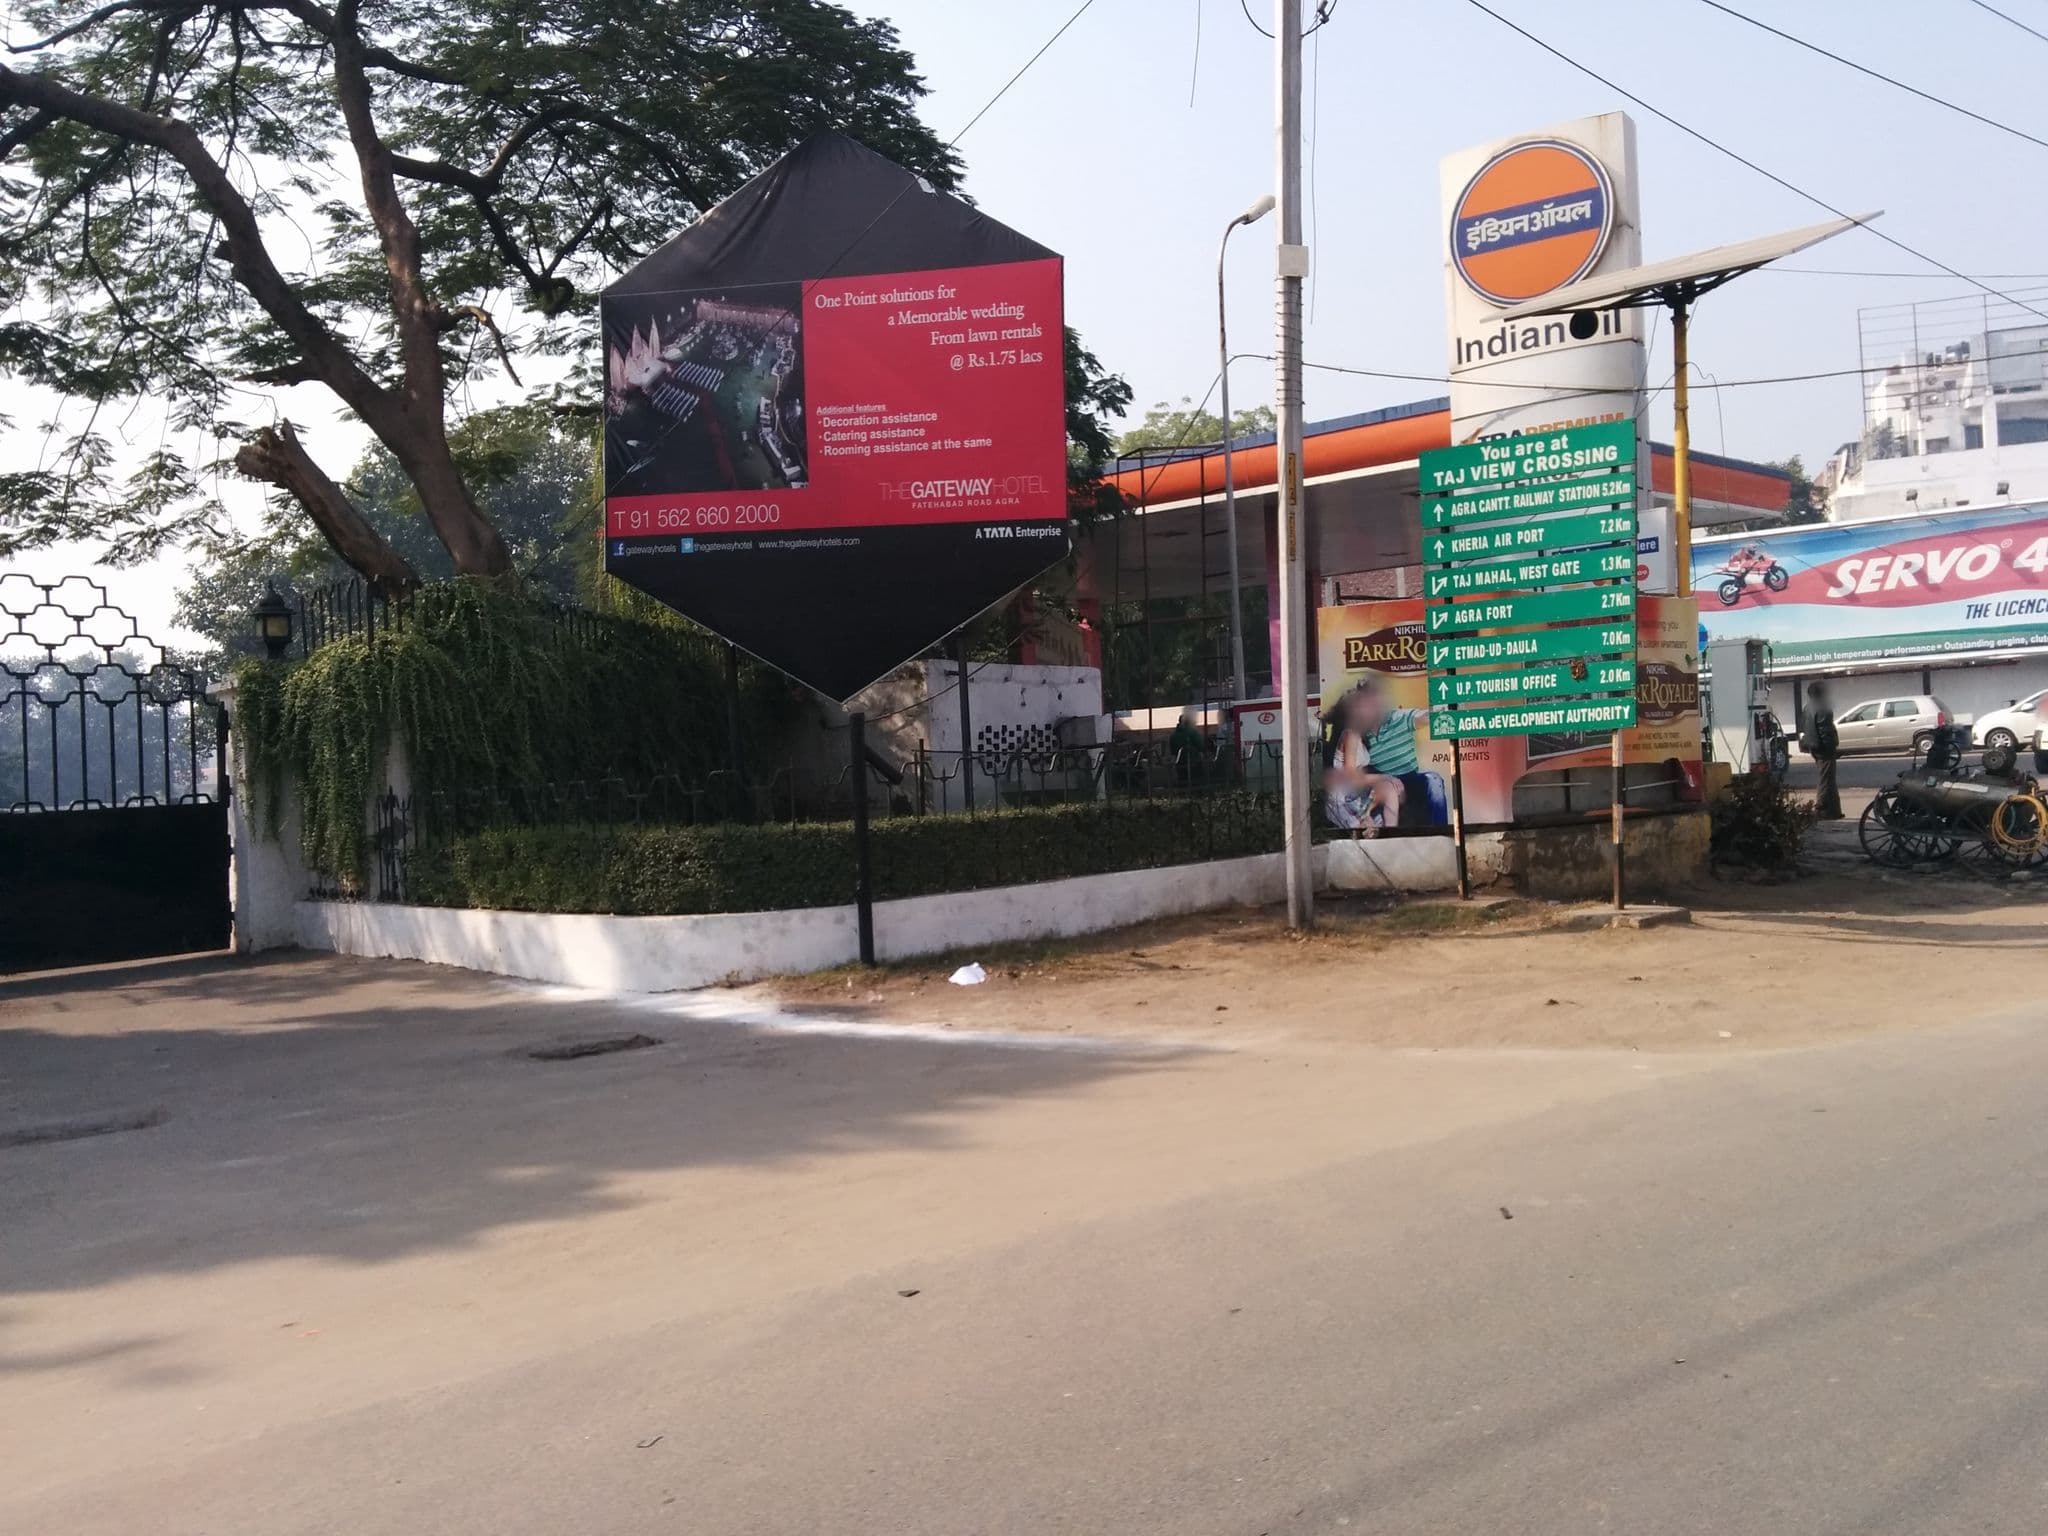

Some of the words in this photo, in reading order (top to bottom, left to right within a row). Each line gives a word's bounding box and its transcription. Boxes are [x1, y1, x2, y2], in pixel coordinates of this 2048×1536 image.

[815, 294, 841, 309] One
[844, 289, 877, 306] Point
[880, 285, 934, 304] solutions
[937, 285, 956, 299] for
[888, 315, 895, 326] a
[899, 305, 968, 325] Memorable
[972, 302, 1025, 320] wedding
[931, 328, 964, 346] From
[968, 327, 998, 343] lawn
[1001, 323, 1042, 340] rentals
[951, 353, 964, 371] @
[968, 350, 1016, 368] Rs.1.75
[1021, 350, 1042, 364] lacs
[817, 405, 854, 415] Additional
[856, 403, 886, 413] features
[823, 413, 879, 428] Decoration
[882, 411, 938, 424] assistance
[824, 428, 867, 443] Catering
[870, 427, 926, 439] assistance
[824, 441, 871, 457] Rooming
[873, 441, 929, 454] assistance
[931, 440, 942, 450] at
[945, 438, 961, 449] the
[963, 437, 993, 449] same
[1480, 446, 1510, 462] You
[1514, 441, 1546, 457] are
[1550, 434, 1569, 451] at
[1433, 467, 1465, 487] TAJ
[1470, 461, 1516, 481] VIEW
[1522, 445, 1619, 474] CROSSING
[967, 498, 992, 507] ROAD
[995, 497, 1021, 505] AGRA
[1451, 502, 1477, 517] AGRA
[1513, 490, 1556, 508] RAILWAY
[1558, 485, 1600, 503] STATION
[614, 511, 626, 530] T
[630, 510, 651, 529] 91
[657, 508, 690, 528] 562
[696, 507, 730, 526] 660
[735, 504, 780, 525] 2000
[975, 528, 983, 539] A
[984, 527, 1014, 538] TATA
[1015, 525, 1062, 538] Enterprise
[1451, 535, 1489, 553] KHERIA
[1494, 531, 1512, 547] AIR
[1517, 528, 1545, 545] PORT
[626, 544, 676, 555] gatewayhotels
[759, 537, 860, 550] www.thegatewayhotels.com
[1453, 574, 1471, 588] TAJ
[1475, 569, 1517, 586] MAHAL,
[1520, 565, 1548, 580] WEST
[1552, 560, 1580, 577] GATE
[1826, 544, 2001, 598] SERVO
[1454, 610, 1482, 624] AGRA
[1486, 605, 1513, 621] FORT
[1966, 602, 1990, 620] THE
[1394, 626, 1426, 636] NIKHIL
[1348, 636, 1427, 663] PARKRO
[1815, 652, 1832, 662] high
[1834, 645, 1882, 659] temperature
[1884, 643, 1936, 657] performance
[1944, 639, 1995, 650] Outstanding
[1456, 682, 1473, 695] U.P.
[1476, 677, 1518, 692] TOURISM
[1522, 673, 1557, 690] OFFICE
[1458, 715, 1486, 731] AGRA
[1567, 705, 1631, 723] AUTHORITY
[1459, 739, 1490, 748] UXURY
